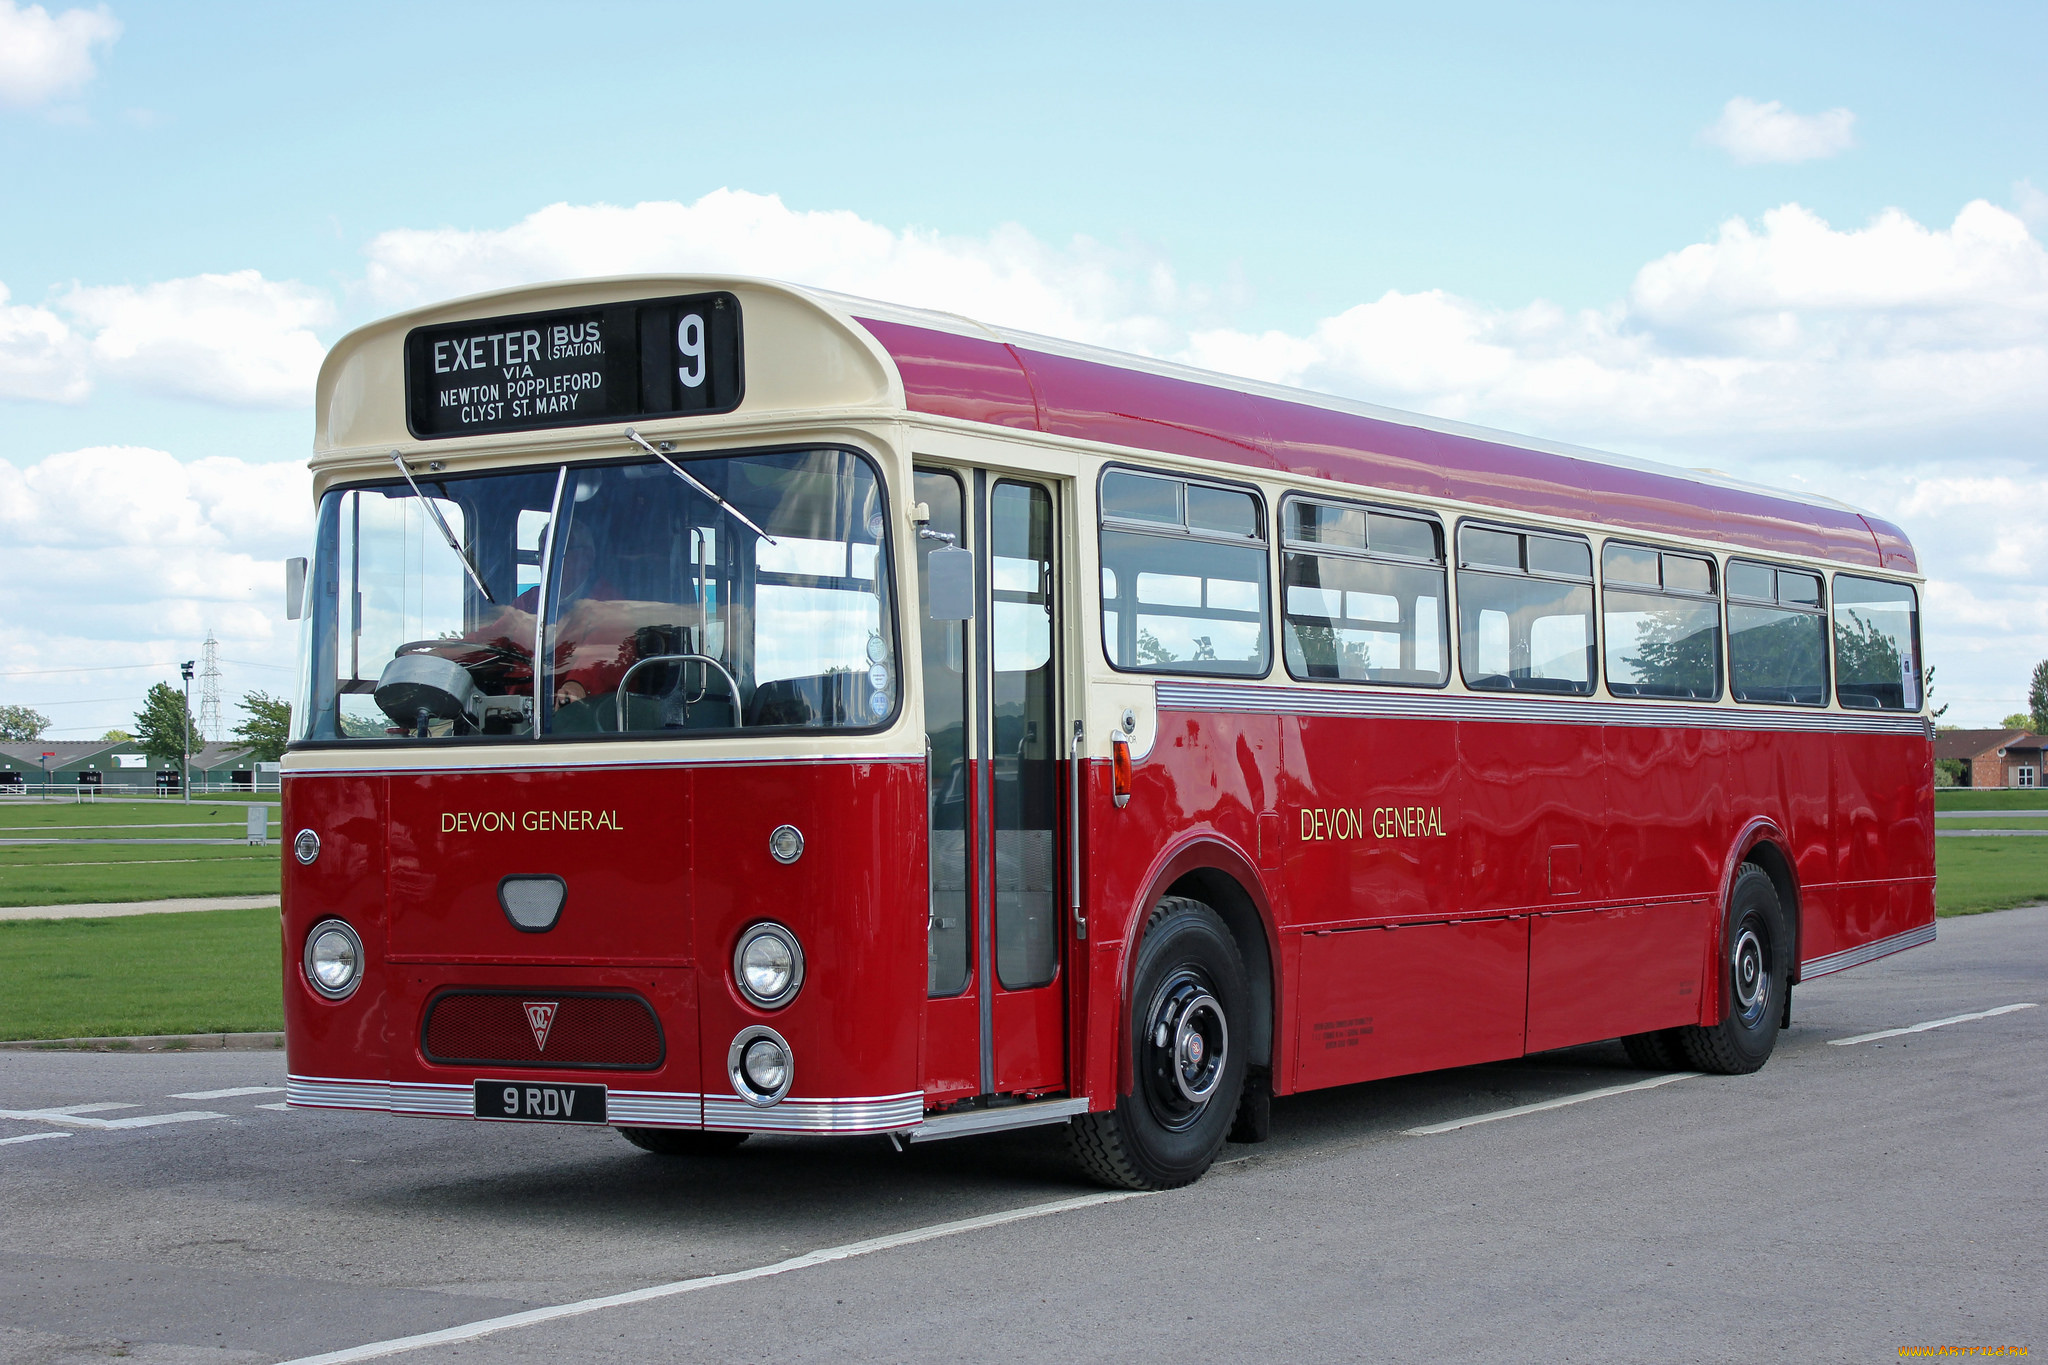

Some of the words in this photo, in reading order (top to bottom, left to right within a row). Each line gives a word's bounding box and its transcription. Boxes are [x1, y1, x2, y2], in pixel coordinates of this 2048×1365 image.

[553, 321, 600, 345] BUS
[434, 329, 541, 374] EXETER
[553, 341, 602, 359] STATION
[677, 313, 706, 388] 9
[503, 364, 534, 380] VIA
[440, 384, 499, 407] NEWTON
[507, 371, 602, 399] POPPLEFORD
[461, 402, 504, 423] CLYST
[441, 811, 515, 833] DEVON
[522, 810, 624, 832] GENERAL
[1301, 808, 1363, 841] DEVON
[1373, 806, 1447, 839] GENERAL
[503, 1087, 519, 1114] 9
[526, 1088, 576, 1117] RDV
